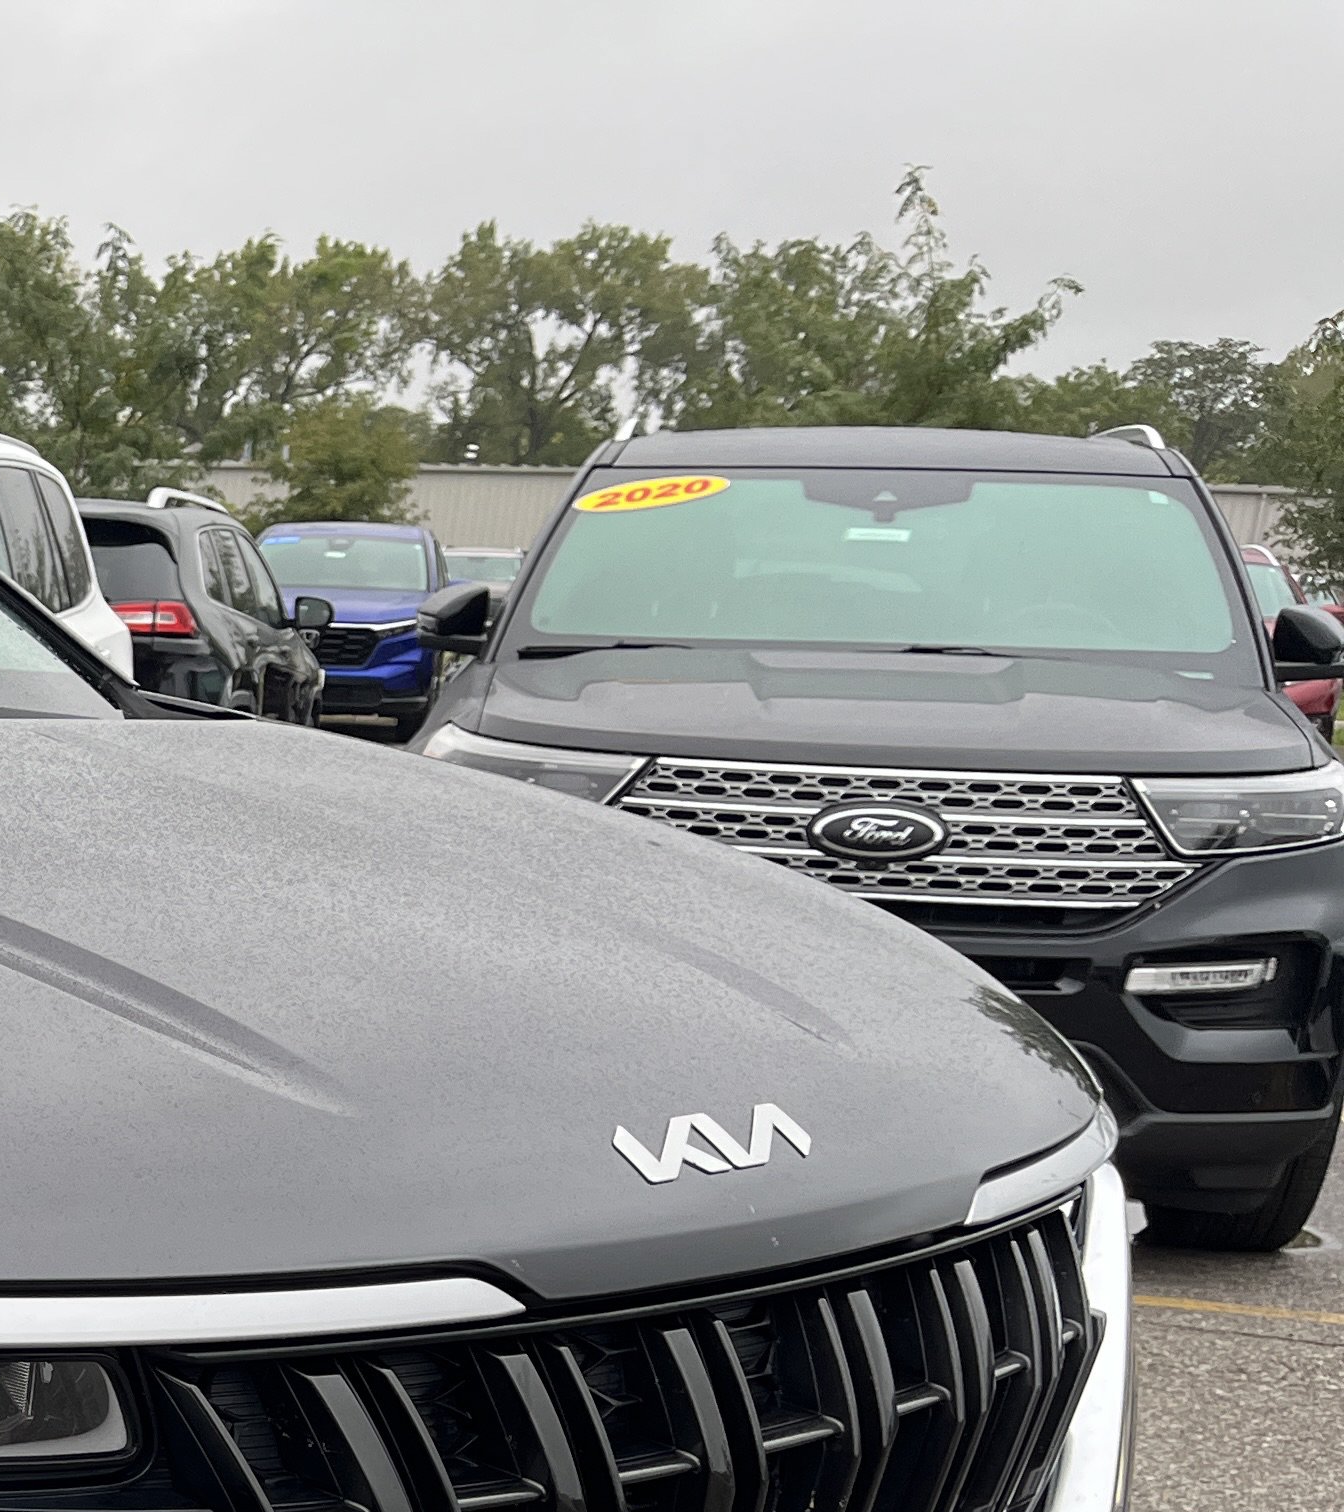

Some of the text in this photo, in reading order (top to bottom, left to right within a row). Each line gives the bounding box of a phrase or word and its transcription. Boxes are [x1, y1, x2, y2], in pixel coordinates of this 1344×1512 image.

[592, 479, 712, 509] 2020
[843, 816, 915, 846] Ford
[612, 1102, 812, 1185] KIA
